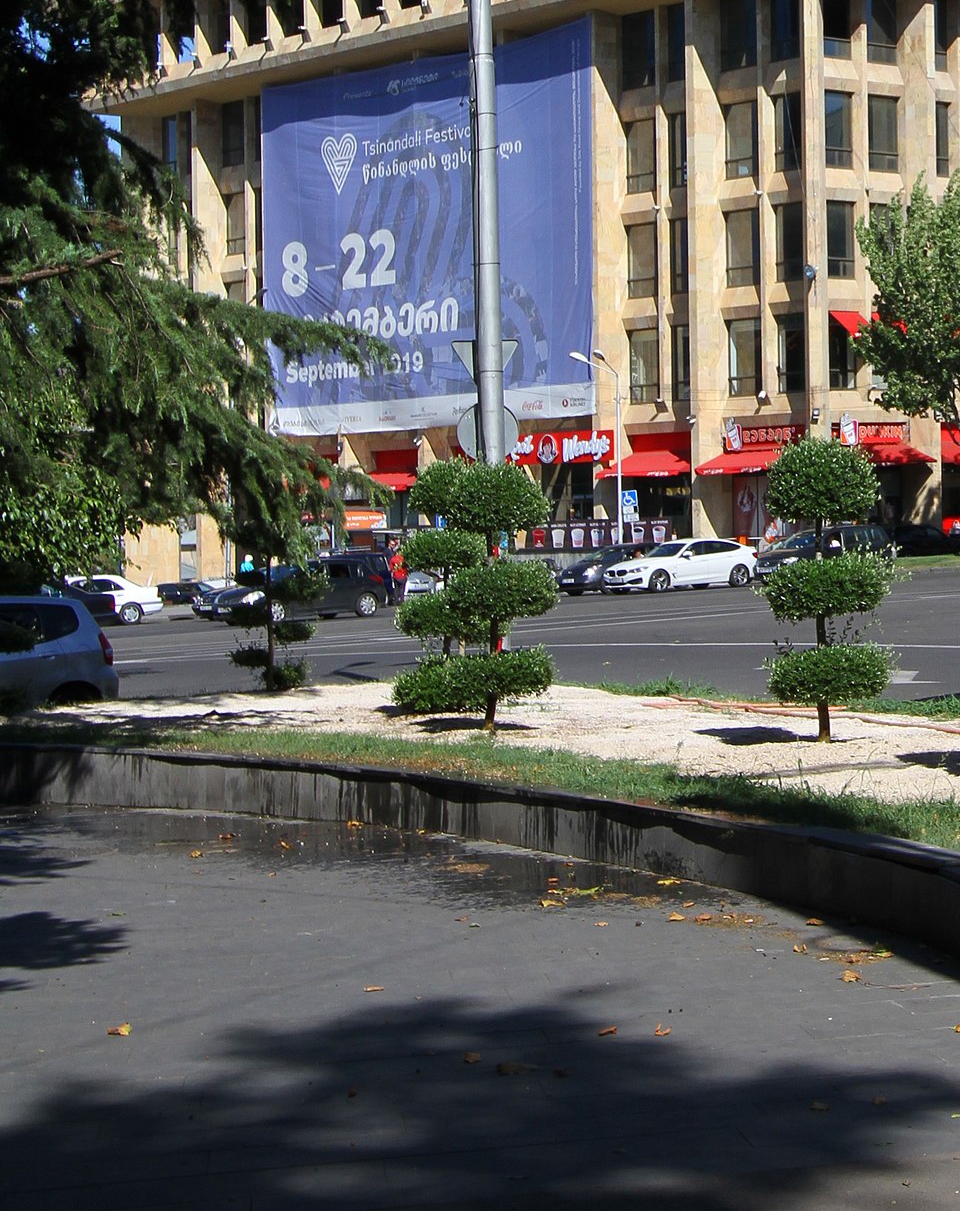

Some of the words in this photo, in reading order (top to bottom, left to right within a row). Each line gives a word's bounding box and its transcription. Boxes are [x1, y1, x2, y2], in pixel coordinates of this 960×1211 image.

[362, 130, 421, 157] Tsinandali
[425, 124, 471, 145] Festiva
[562, 430, 610, 464] Wendy's
